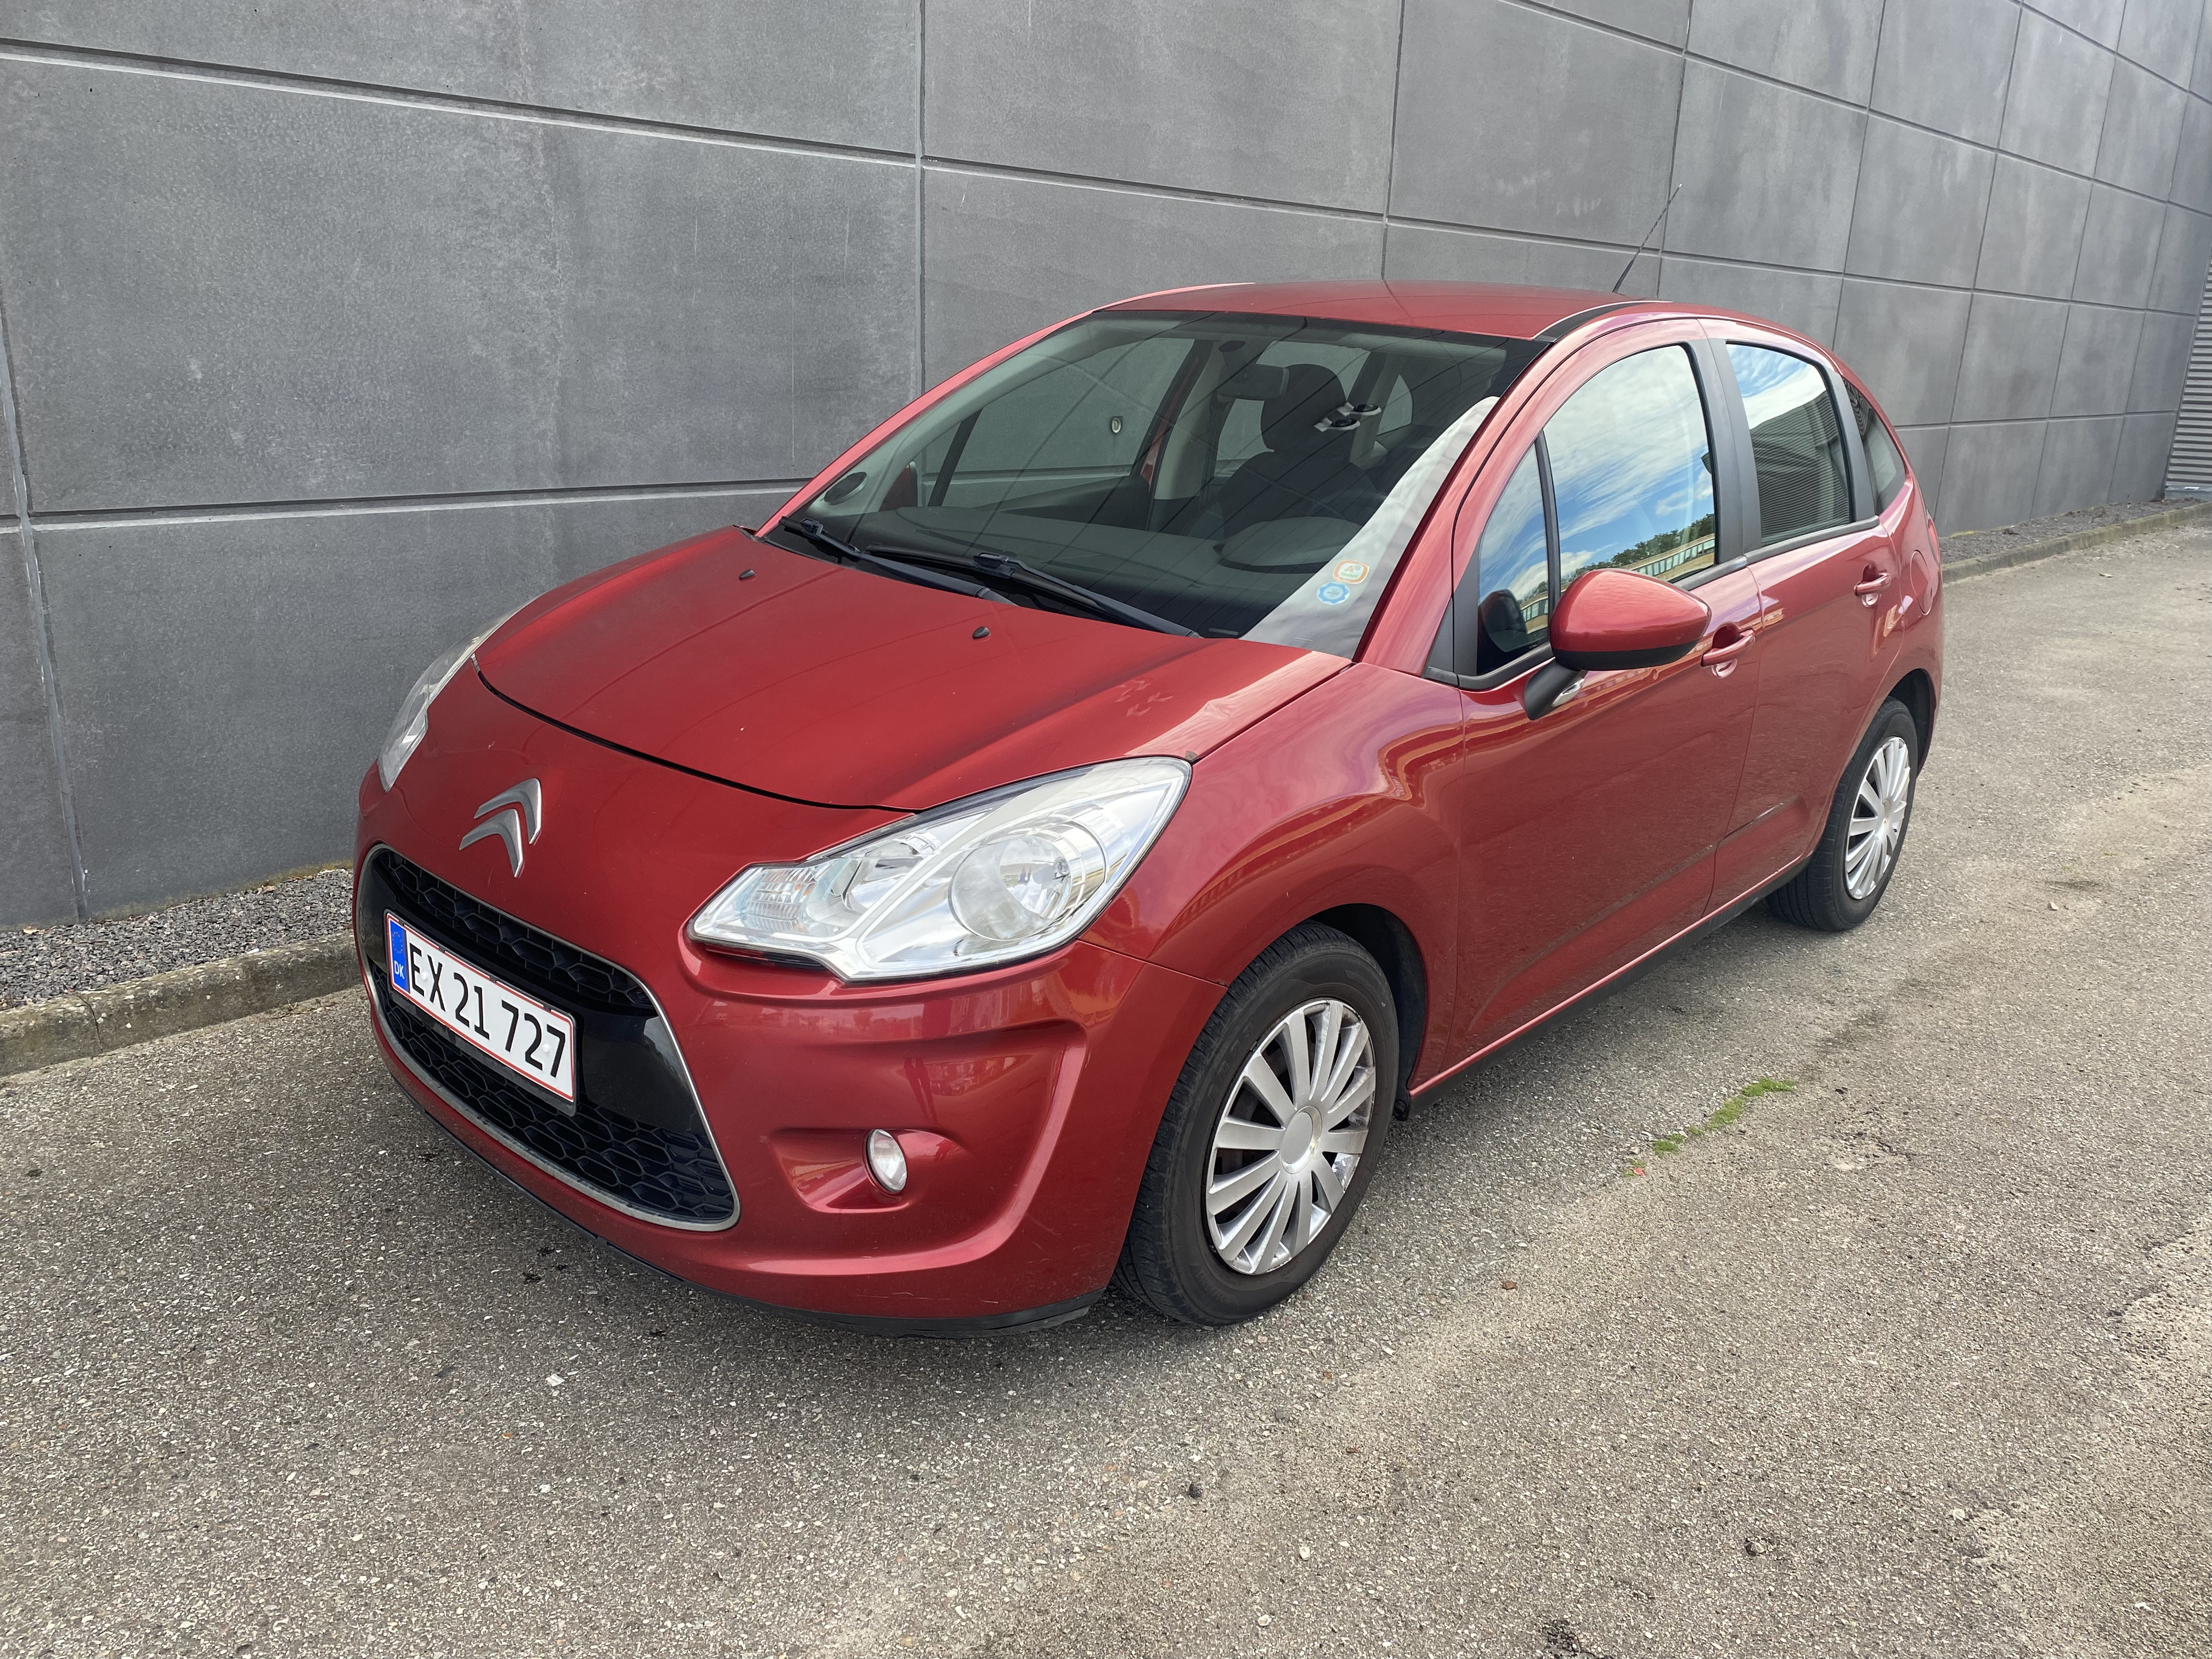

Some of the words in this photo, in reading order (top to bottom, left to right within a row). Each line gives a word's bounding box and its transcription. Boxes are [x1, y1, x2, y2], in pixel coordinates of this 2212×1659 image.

[394, 960, 405, 980] DK
[409, 943, 446, 1012] EX
[453, 972, 490, 1040] 21
[501, 1000, 566, 1078] 727
